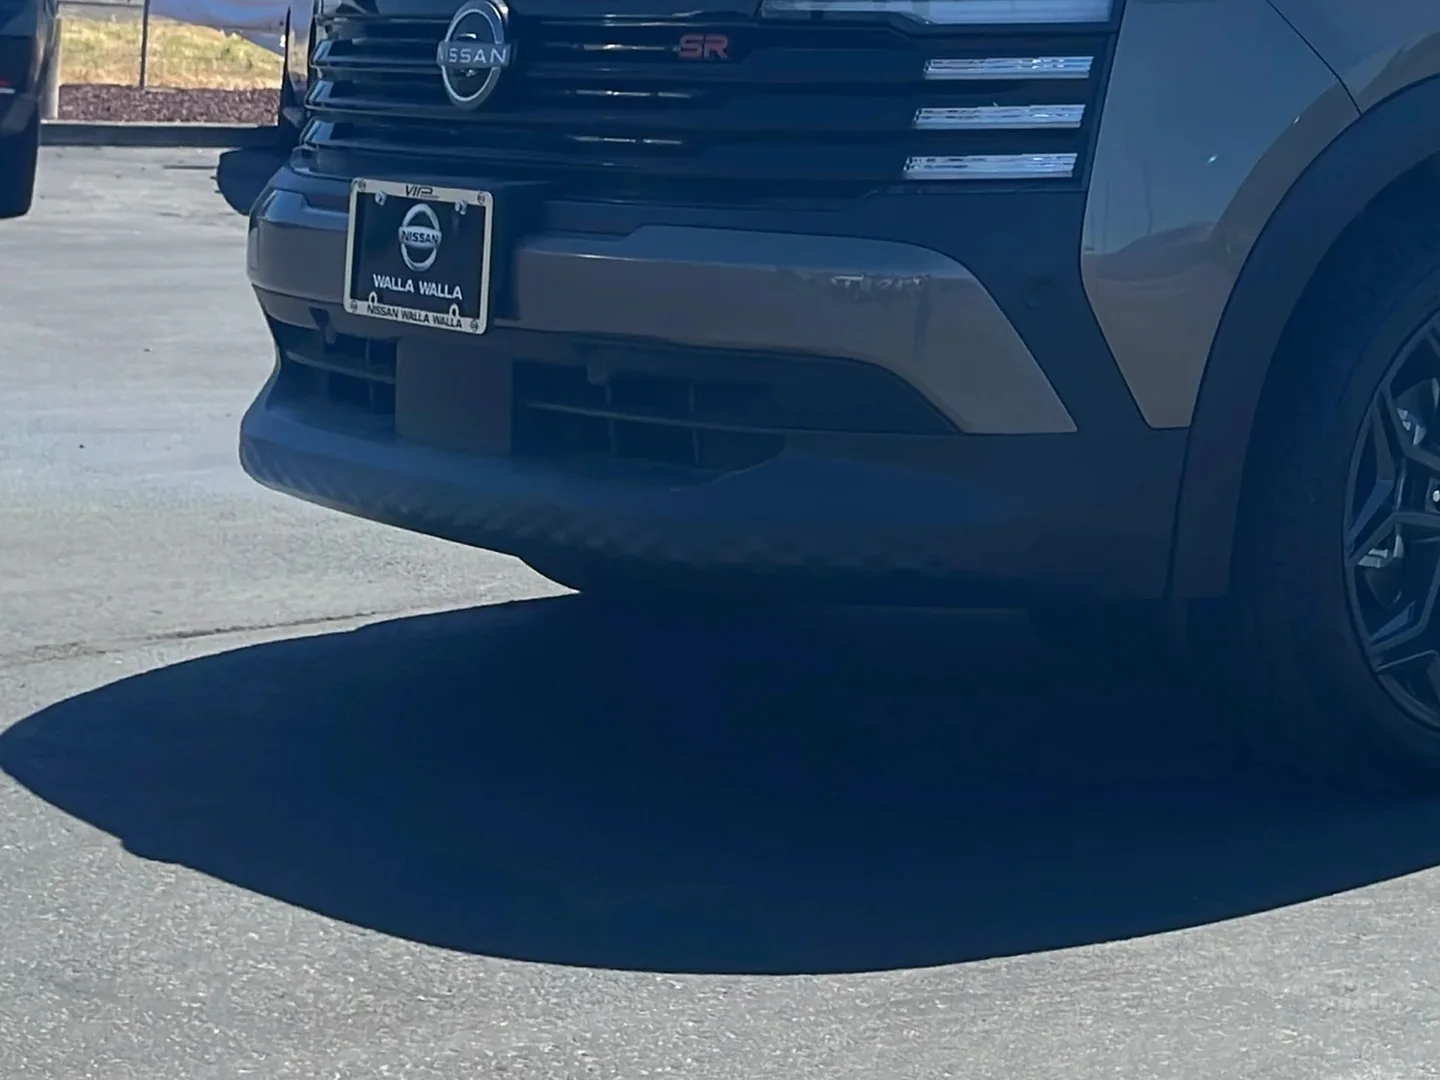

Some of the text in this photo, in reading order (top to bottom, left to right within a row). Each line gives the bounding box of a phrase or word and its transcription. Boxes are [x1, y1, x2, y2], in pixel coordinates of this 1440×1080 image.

[678, 33, 730, 60] SR
[401, 231, 439, 244] NISSAN
[373, 274, 462, 300] WALLA WALLA
[367, 305, 462, 329] NISSAN WALLA WALLA
